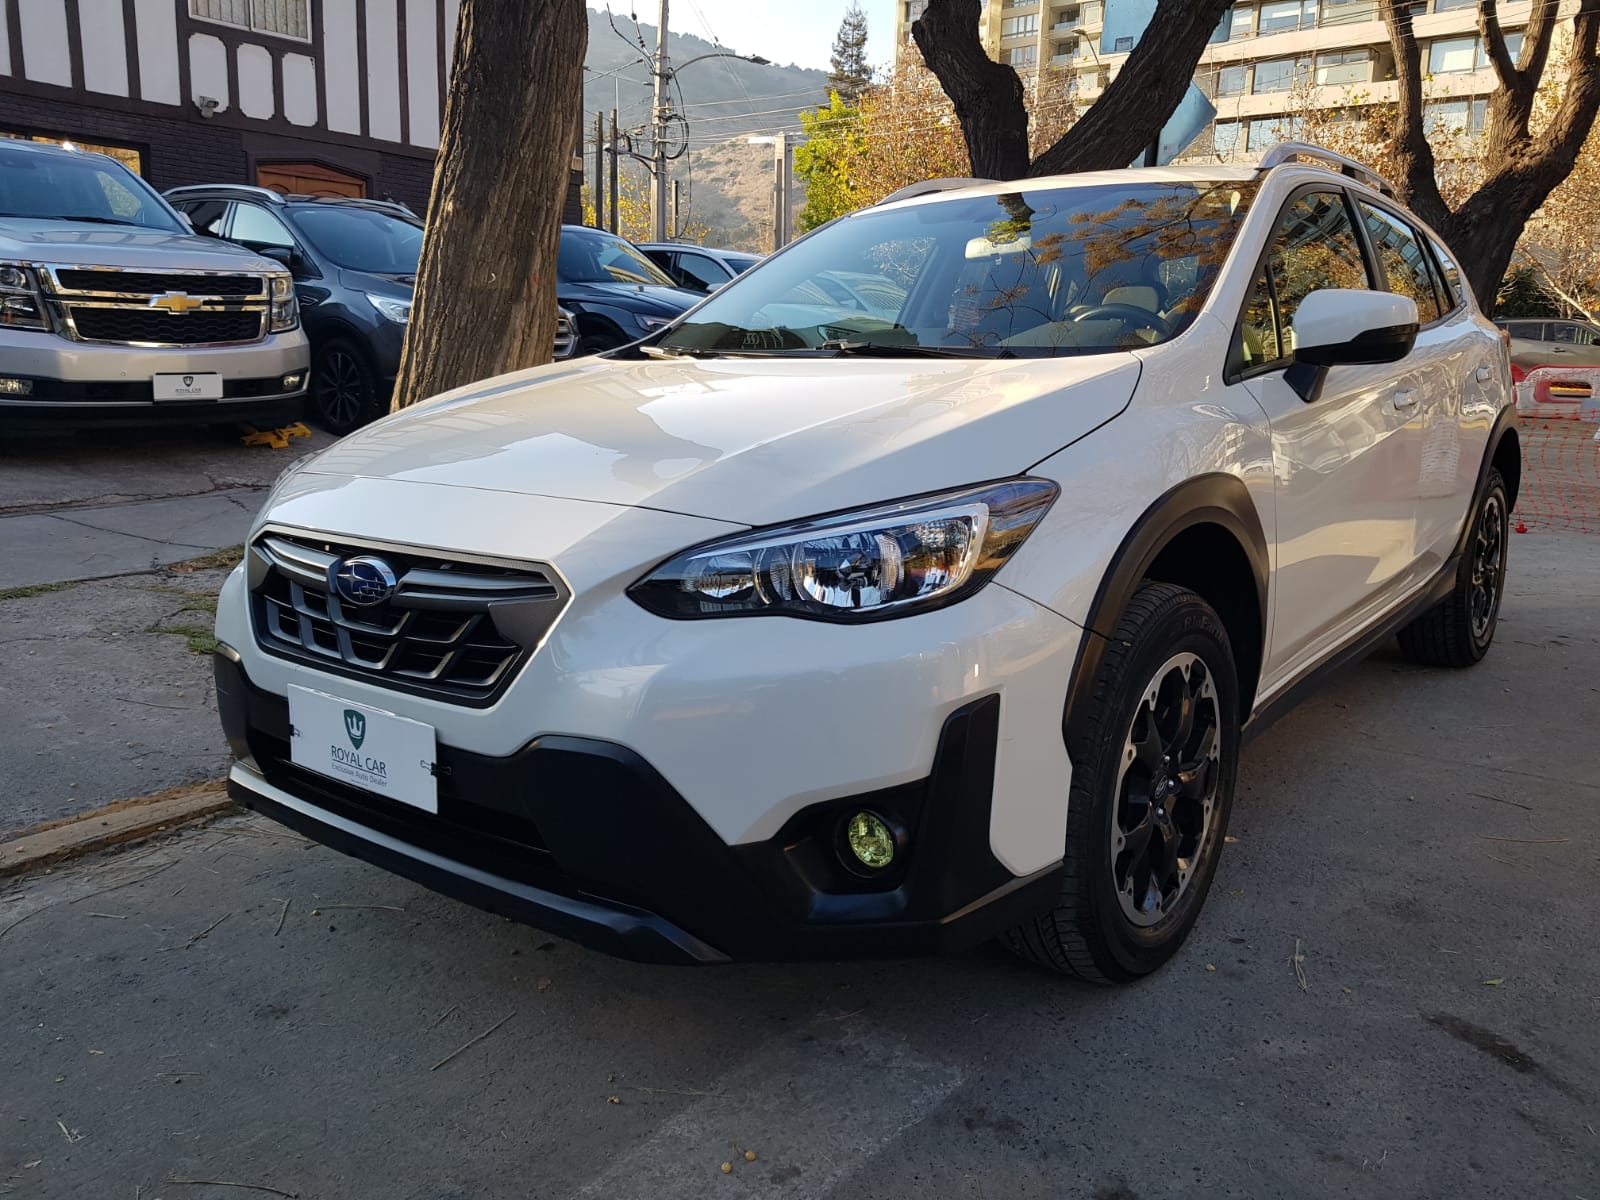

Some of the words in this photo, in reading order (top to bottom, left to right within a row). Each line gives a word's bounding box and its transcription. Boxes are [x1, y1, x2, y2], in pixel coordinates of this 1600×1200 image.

[331, 745, 362, 768] ROYAL
[365, 757, 387, 775] CAR
[355, 770, 369, 781] Auto
[370, 776, 388, 788] Dealer
